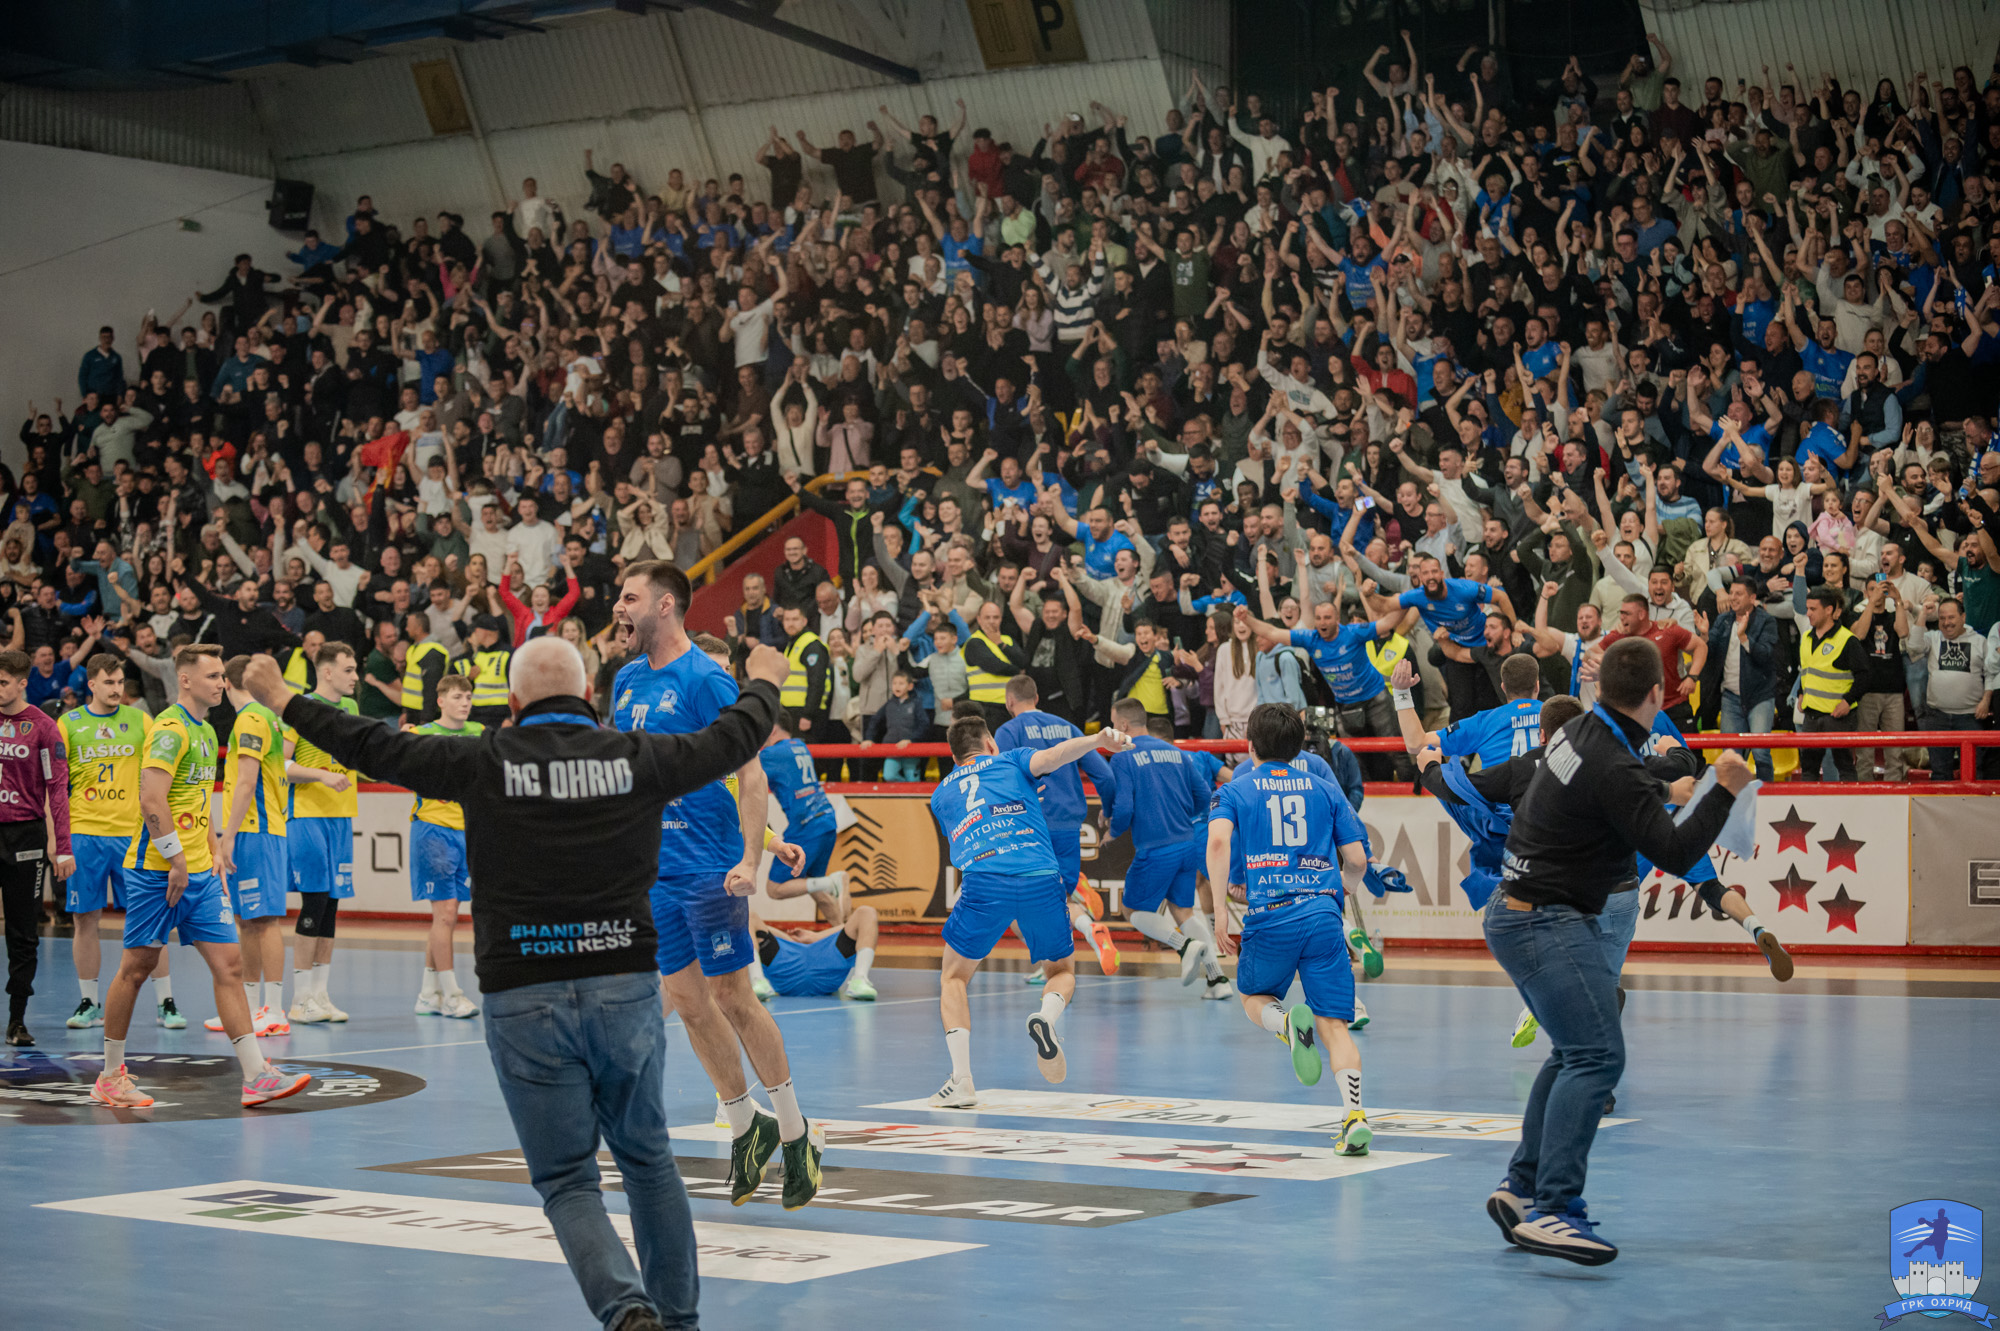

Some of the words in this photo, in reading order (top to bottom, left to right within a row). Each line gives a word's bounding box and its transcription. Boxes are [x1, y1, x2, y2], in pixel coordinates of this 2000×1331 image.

[1511, 714, 1541, 729] DJUKI
[1025, 725, 1042, 740] HC
[1042, 725, 1072, 740] OHRID
[77, 743, 135, 763] LAŠKO
[1133, 750, 1150, 767] HC
[1151, 749, 1183, 764] OHRID
[98, 763, 114, 783] 21
[503, 759, 542, 797] HC
[548, 757, 634, 799] OHRID
[958, 773, 986, 813] 2
[1252, 777, 1313, 792] YASUHIRA
[993, 803, 1024, 815] Andros
[1266, 794, 1308, 847] 13
[963, 818, 1016, 845] AITONIX
[1300, 857, 1330, 869] Andros
[1257, 873, 1321, 886] AITONIX
[509, 918, 638, 941] #HANDBALL
[520, 934, 633, 956] FORTRESS
[389, 1215, 547, 1236] LTH
